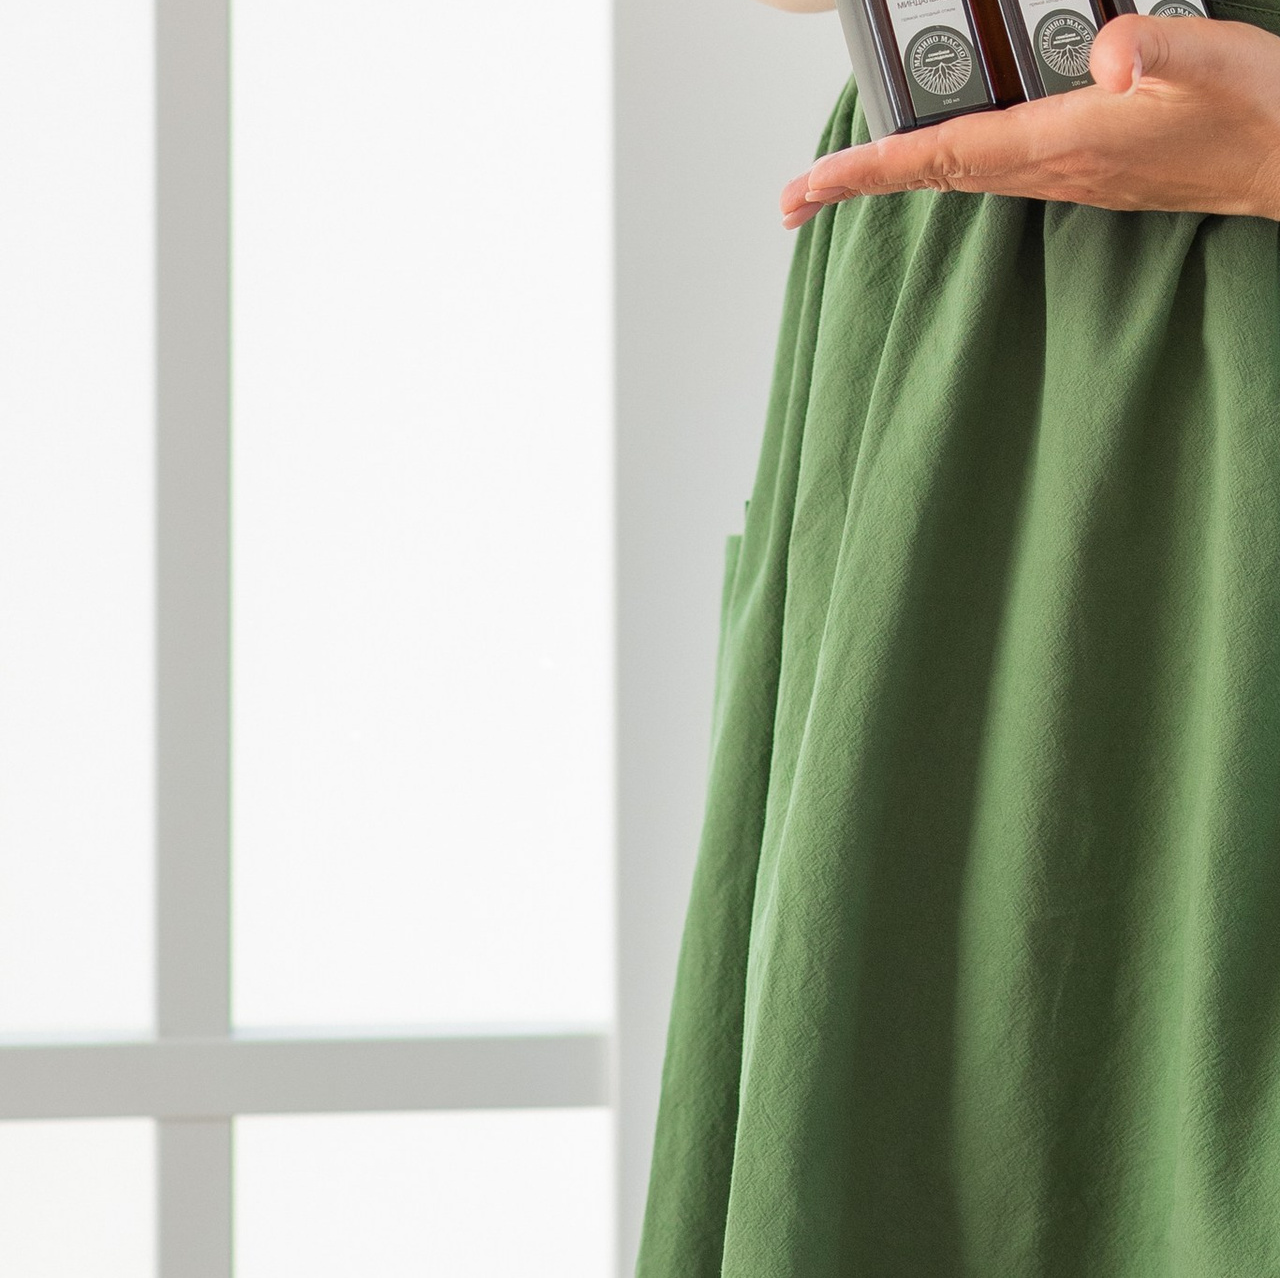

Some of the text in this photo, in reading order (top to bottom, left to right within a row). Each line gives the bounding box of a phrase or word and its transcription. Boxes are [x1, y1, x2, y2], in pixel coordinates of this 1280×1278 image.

[1042, 18, 1092, 49] МАМИНО МАСЛО
[914, 35, 966, 67] МАМИНО МАСЛО
[942, 97, 952, 105] 100
